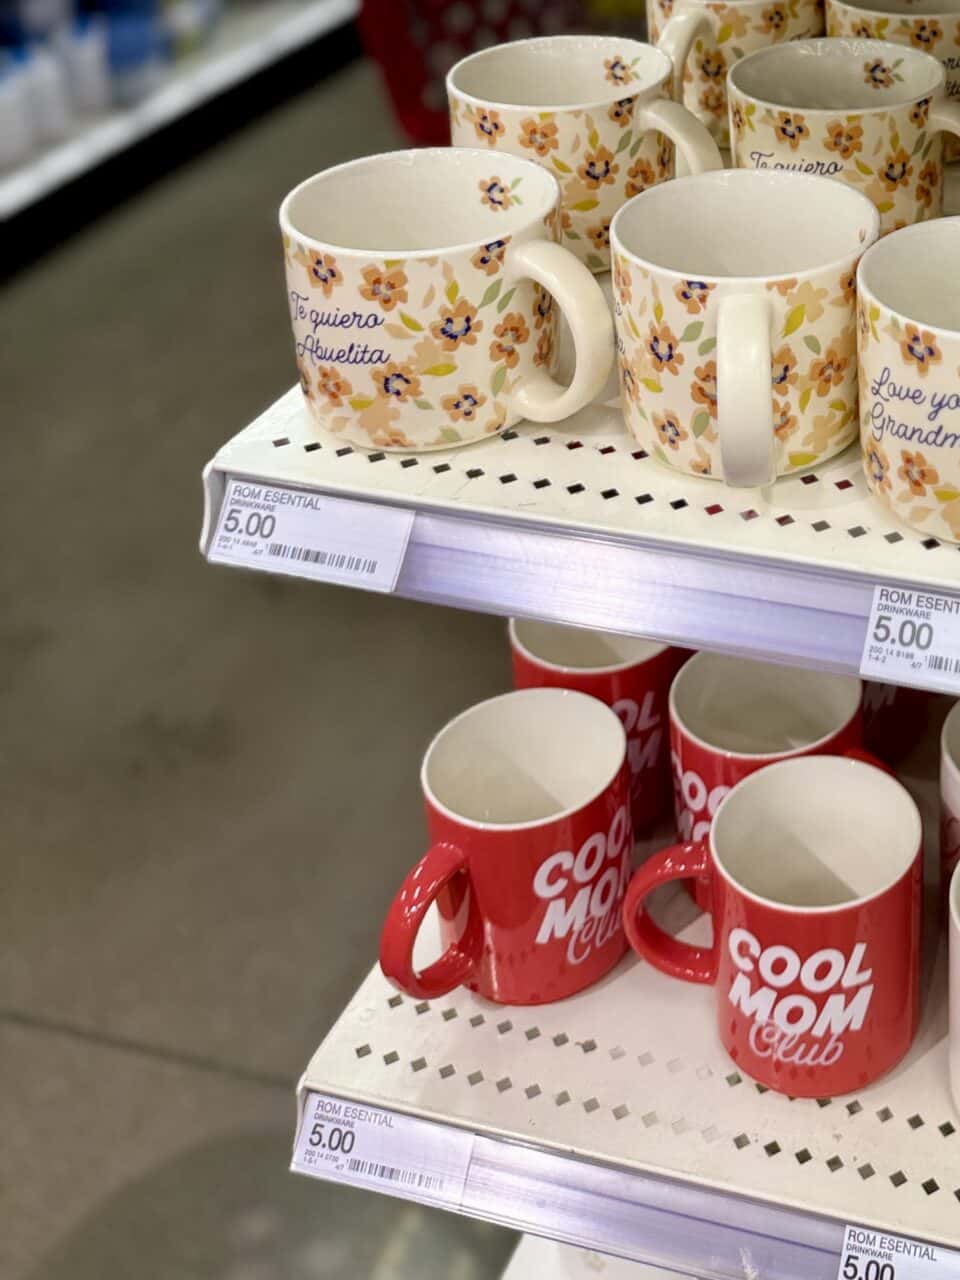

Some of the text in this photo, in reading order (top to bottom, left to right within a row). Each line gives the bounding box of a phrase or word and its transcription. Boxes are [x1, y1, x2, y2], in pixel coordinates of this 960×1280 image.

[290, 290, 385, 334] Te quiero
[296, 334, 391, 366] Abuelita
[871, 367, 927, 405] Love
[232, 484, 321, 511] ROM ESENTIAL
[224, 508, 277, 539] 5.00
[876, 603, 932, 620] DRINKWARE
[879, 588, 913, 606] ROM
[873, 614, 934, 651] 5.00
[729, 927, 873, 994] COOL
[728, 971, 875, 1038] MOM
[749, 1020, 845, 1067] Club
[316, 1100, 395, 1129] ROM ESENTIAL
[308, 1122, 356, 1155] 5.00
[846, 1244, 894, 1261] DRINKWARE
[847, 1230, 937, 1262] ROM ESENTIAL
[843, 1255, 895, 1280] 5.00
